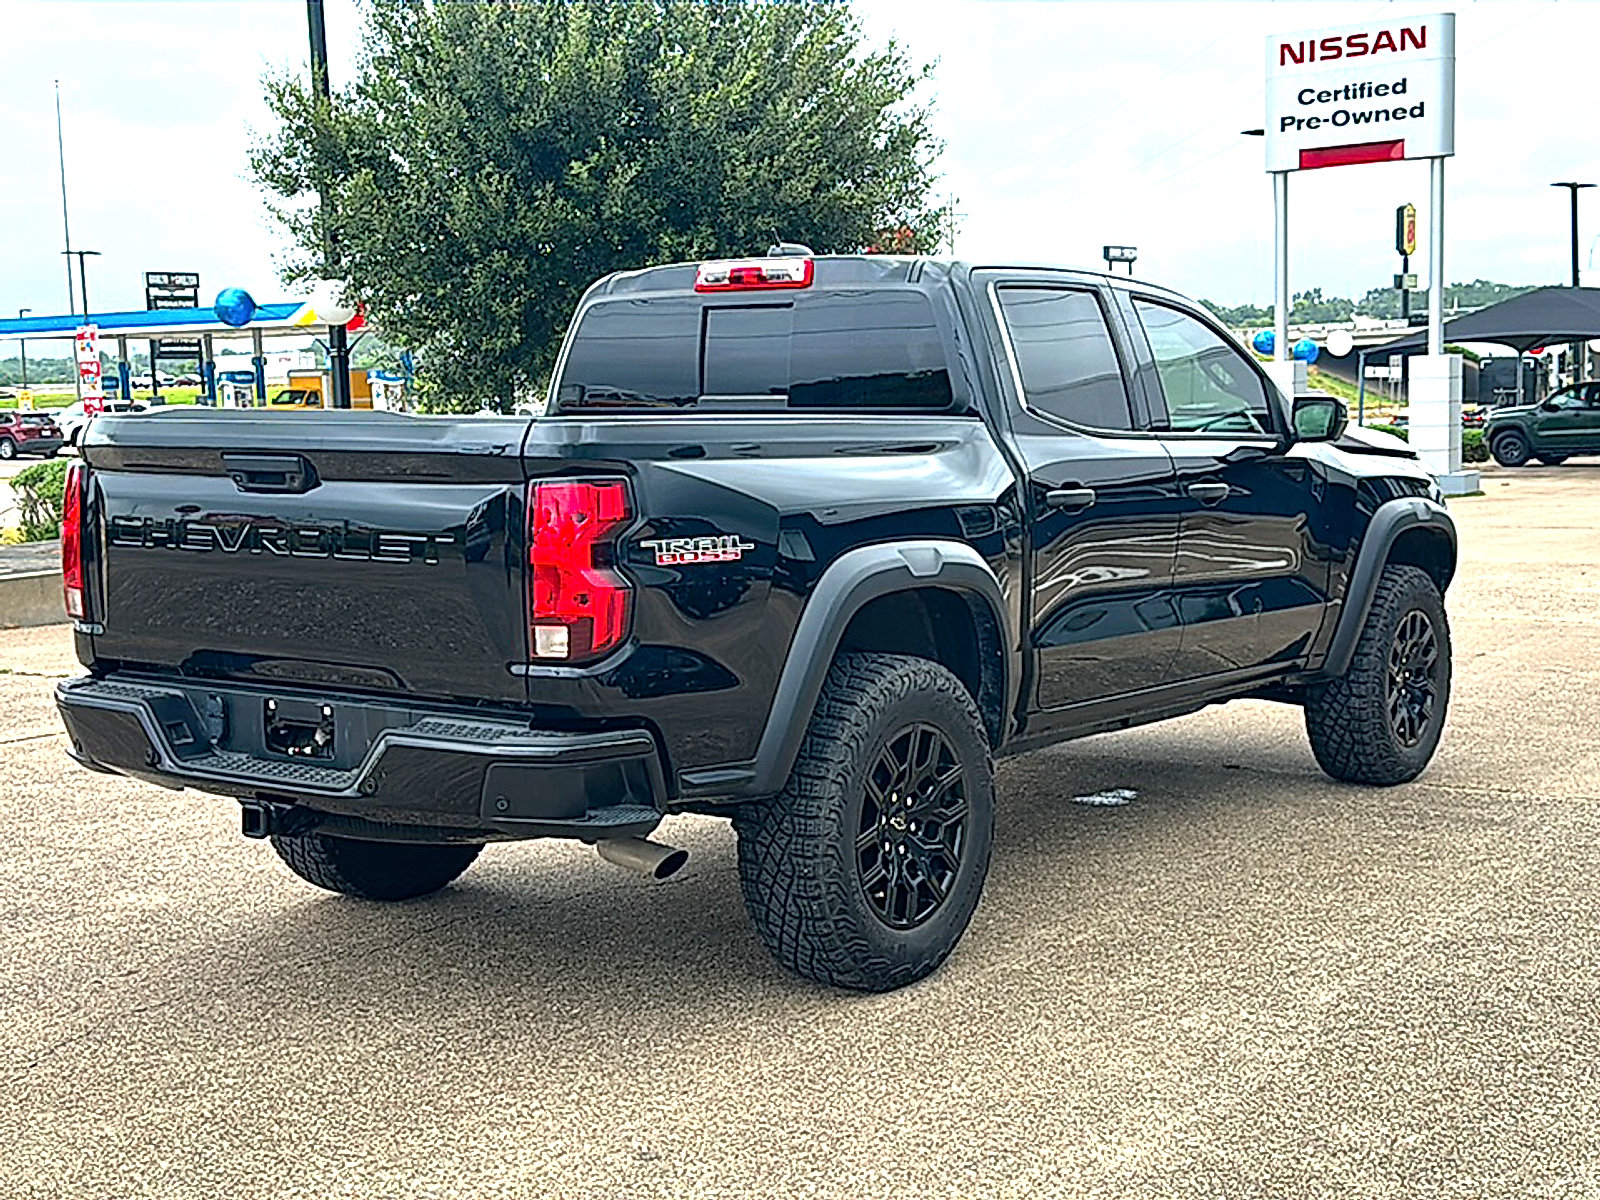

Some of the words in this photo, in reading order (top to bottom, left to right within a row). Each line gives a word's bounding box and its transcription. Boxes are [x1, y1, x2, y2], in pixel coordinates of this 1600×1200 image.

[1280, 25, 1426, 66] NISSAN
[1297, 77, 1407, 105] Certified
[1280, 101, 1425, 132] Pre-Owned
[111, 516, 455, 564] CHEVROLET
[640, 535, 754, 553] TRAIL
[656, 549, 741, 565] BOSS
